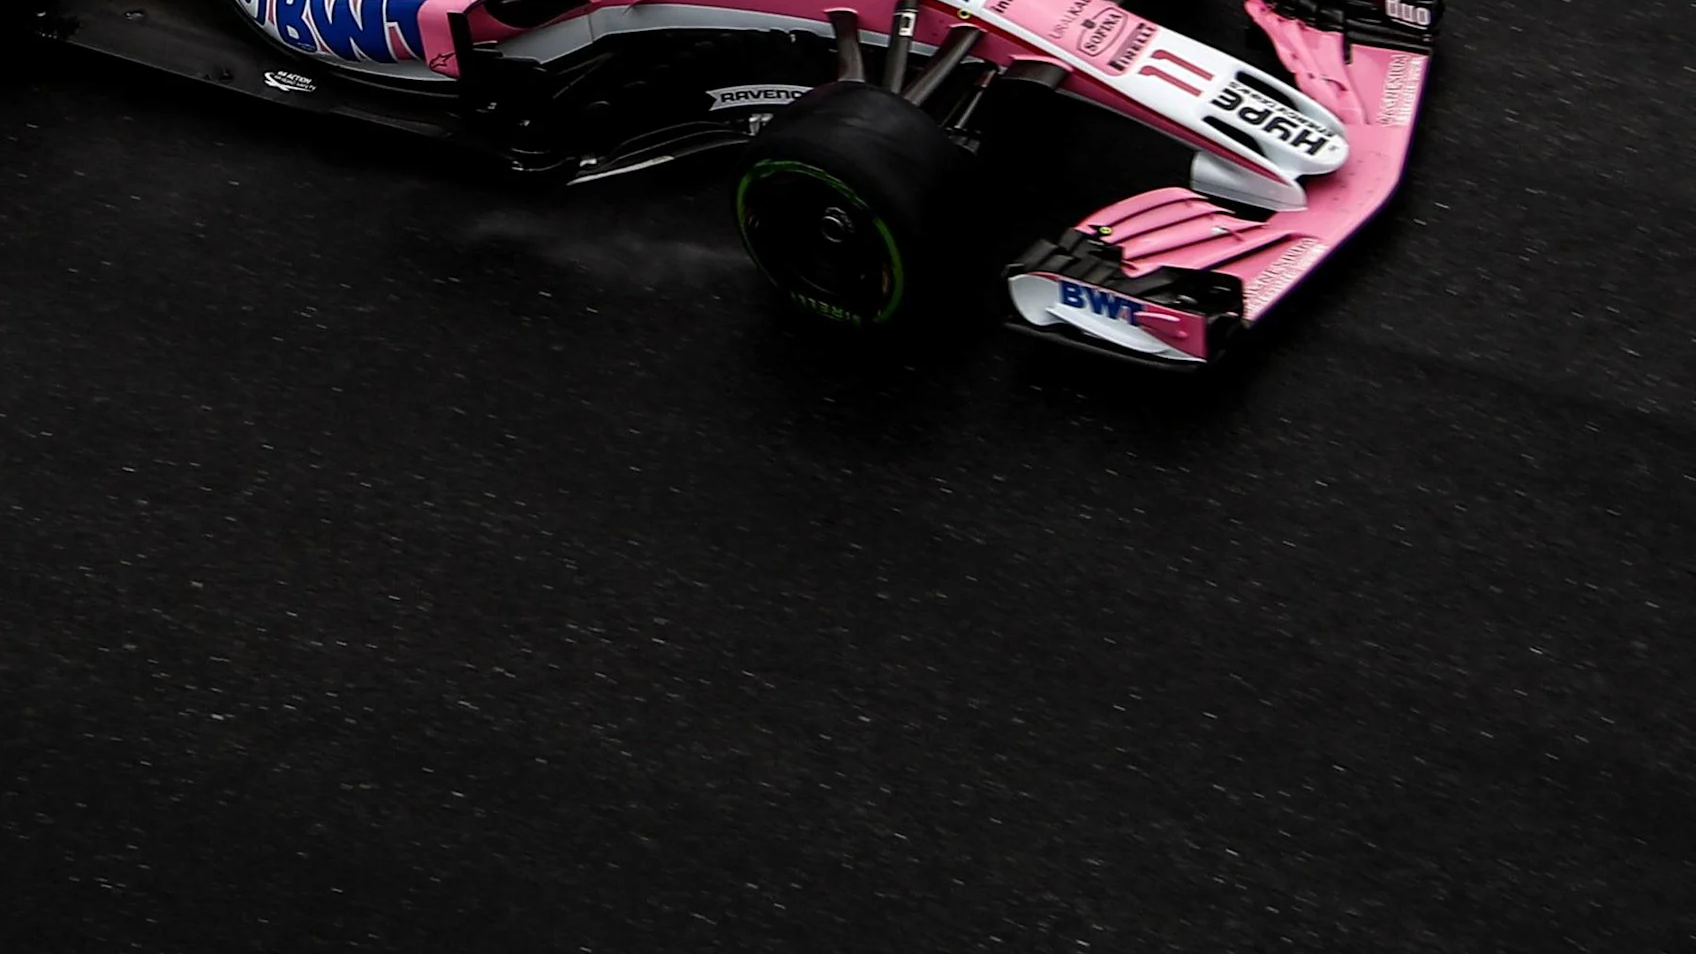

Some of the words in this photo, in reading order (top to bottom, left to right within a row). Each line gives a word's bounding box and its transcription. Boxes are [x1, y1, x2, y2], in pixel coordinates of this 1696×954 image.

[721, 89, 804, 104] RAVENO
[1138, 49, 1214, 97] 11
[1210, 88, 1329, 156] HYPE
[1058, 280, 1145, 326] BWT
